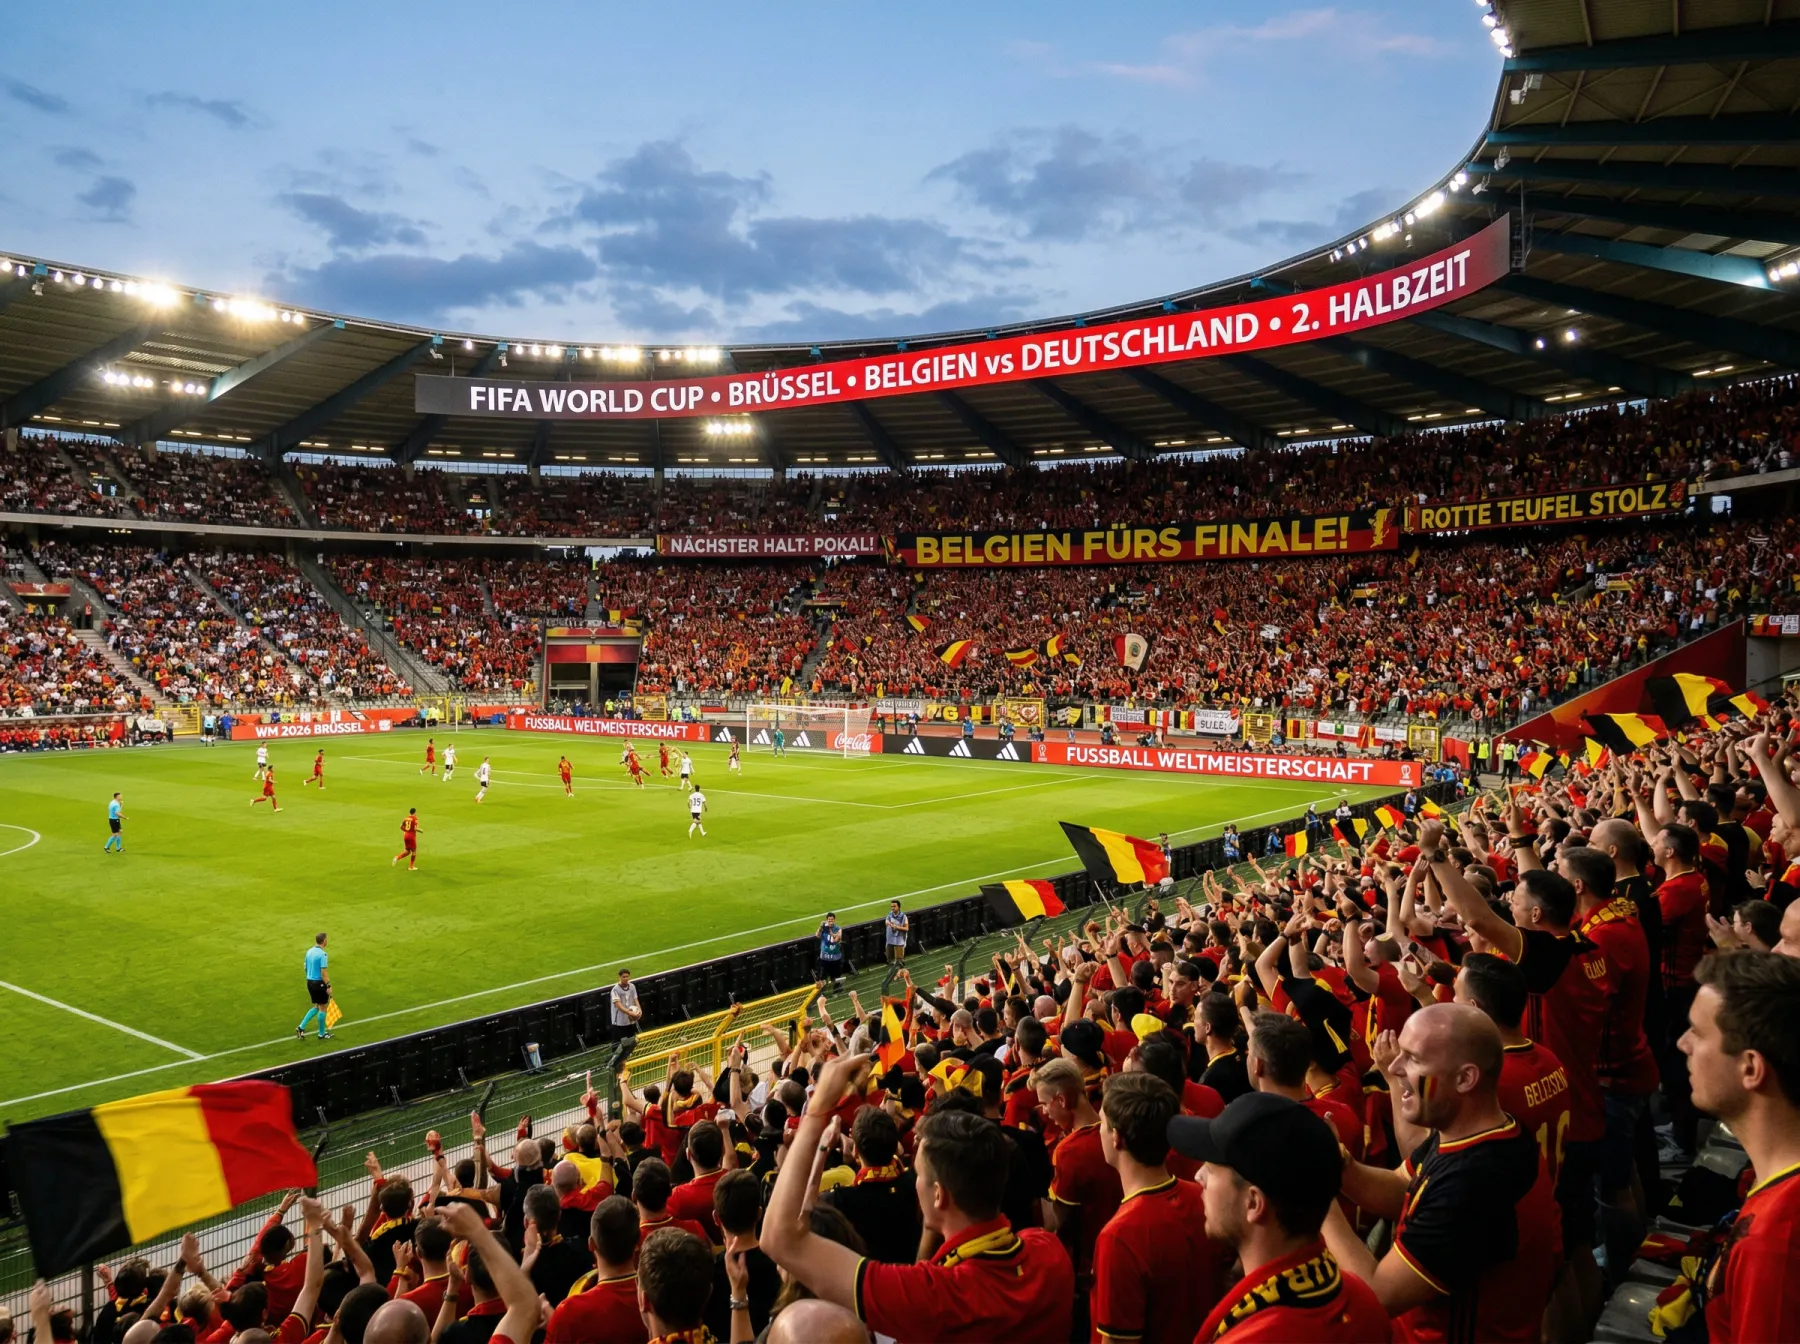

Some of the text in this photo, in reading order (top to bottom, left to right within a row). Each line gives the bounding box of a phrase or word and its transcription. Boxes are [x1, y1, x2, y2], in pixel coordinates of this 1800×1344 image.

[470, 250, 1471, 413] FIFA WORLD CUP BRÜSSEL BELGIEN vs DEUTSCHLAND 2. HALBZEIT
[1421, 485, 1666, 529] ROTTE TEUFEL STOLZ
[671, 533, 874, 554] NÄCHSTER HALT: POKAL!
[916, 517, 1349, 564] BELGIEN FÜRS FINALE!
[255, 721, 364, 738] WM 2026 BRÜSSEL
[524, 717, 688, 738] FUSSBALL WELTMEISTERSCHAFT
[1066, 746, 1374, 782] FUSSBALL WELTMEISTERSCHAFT
